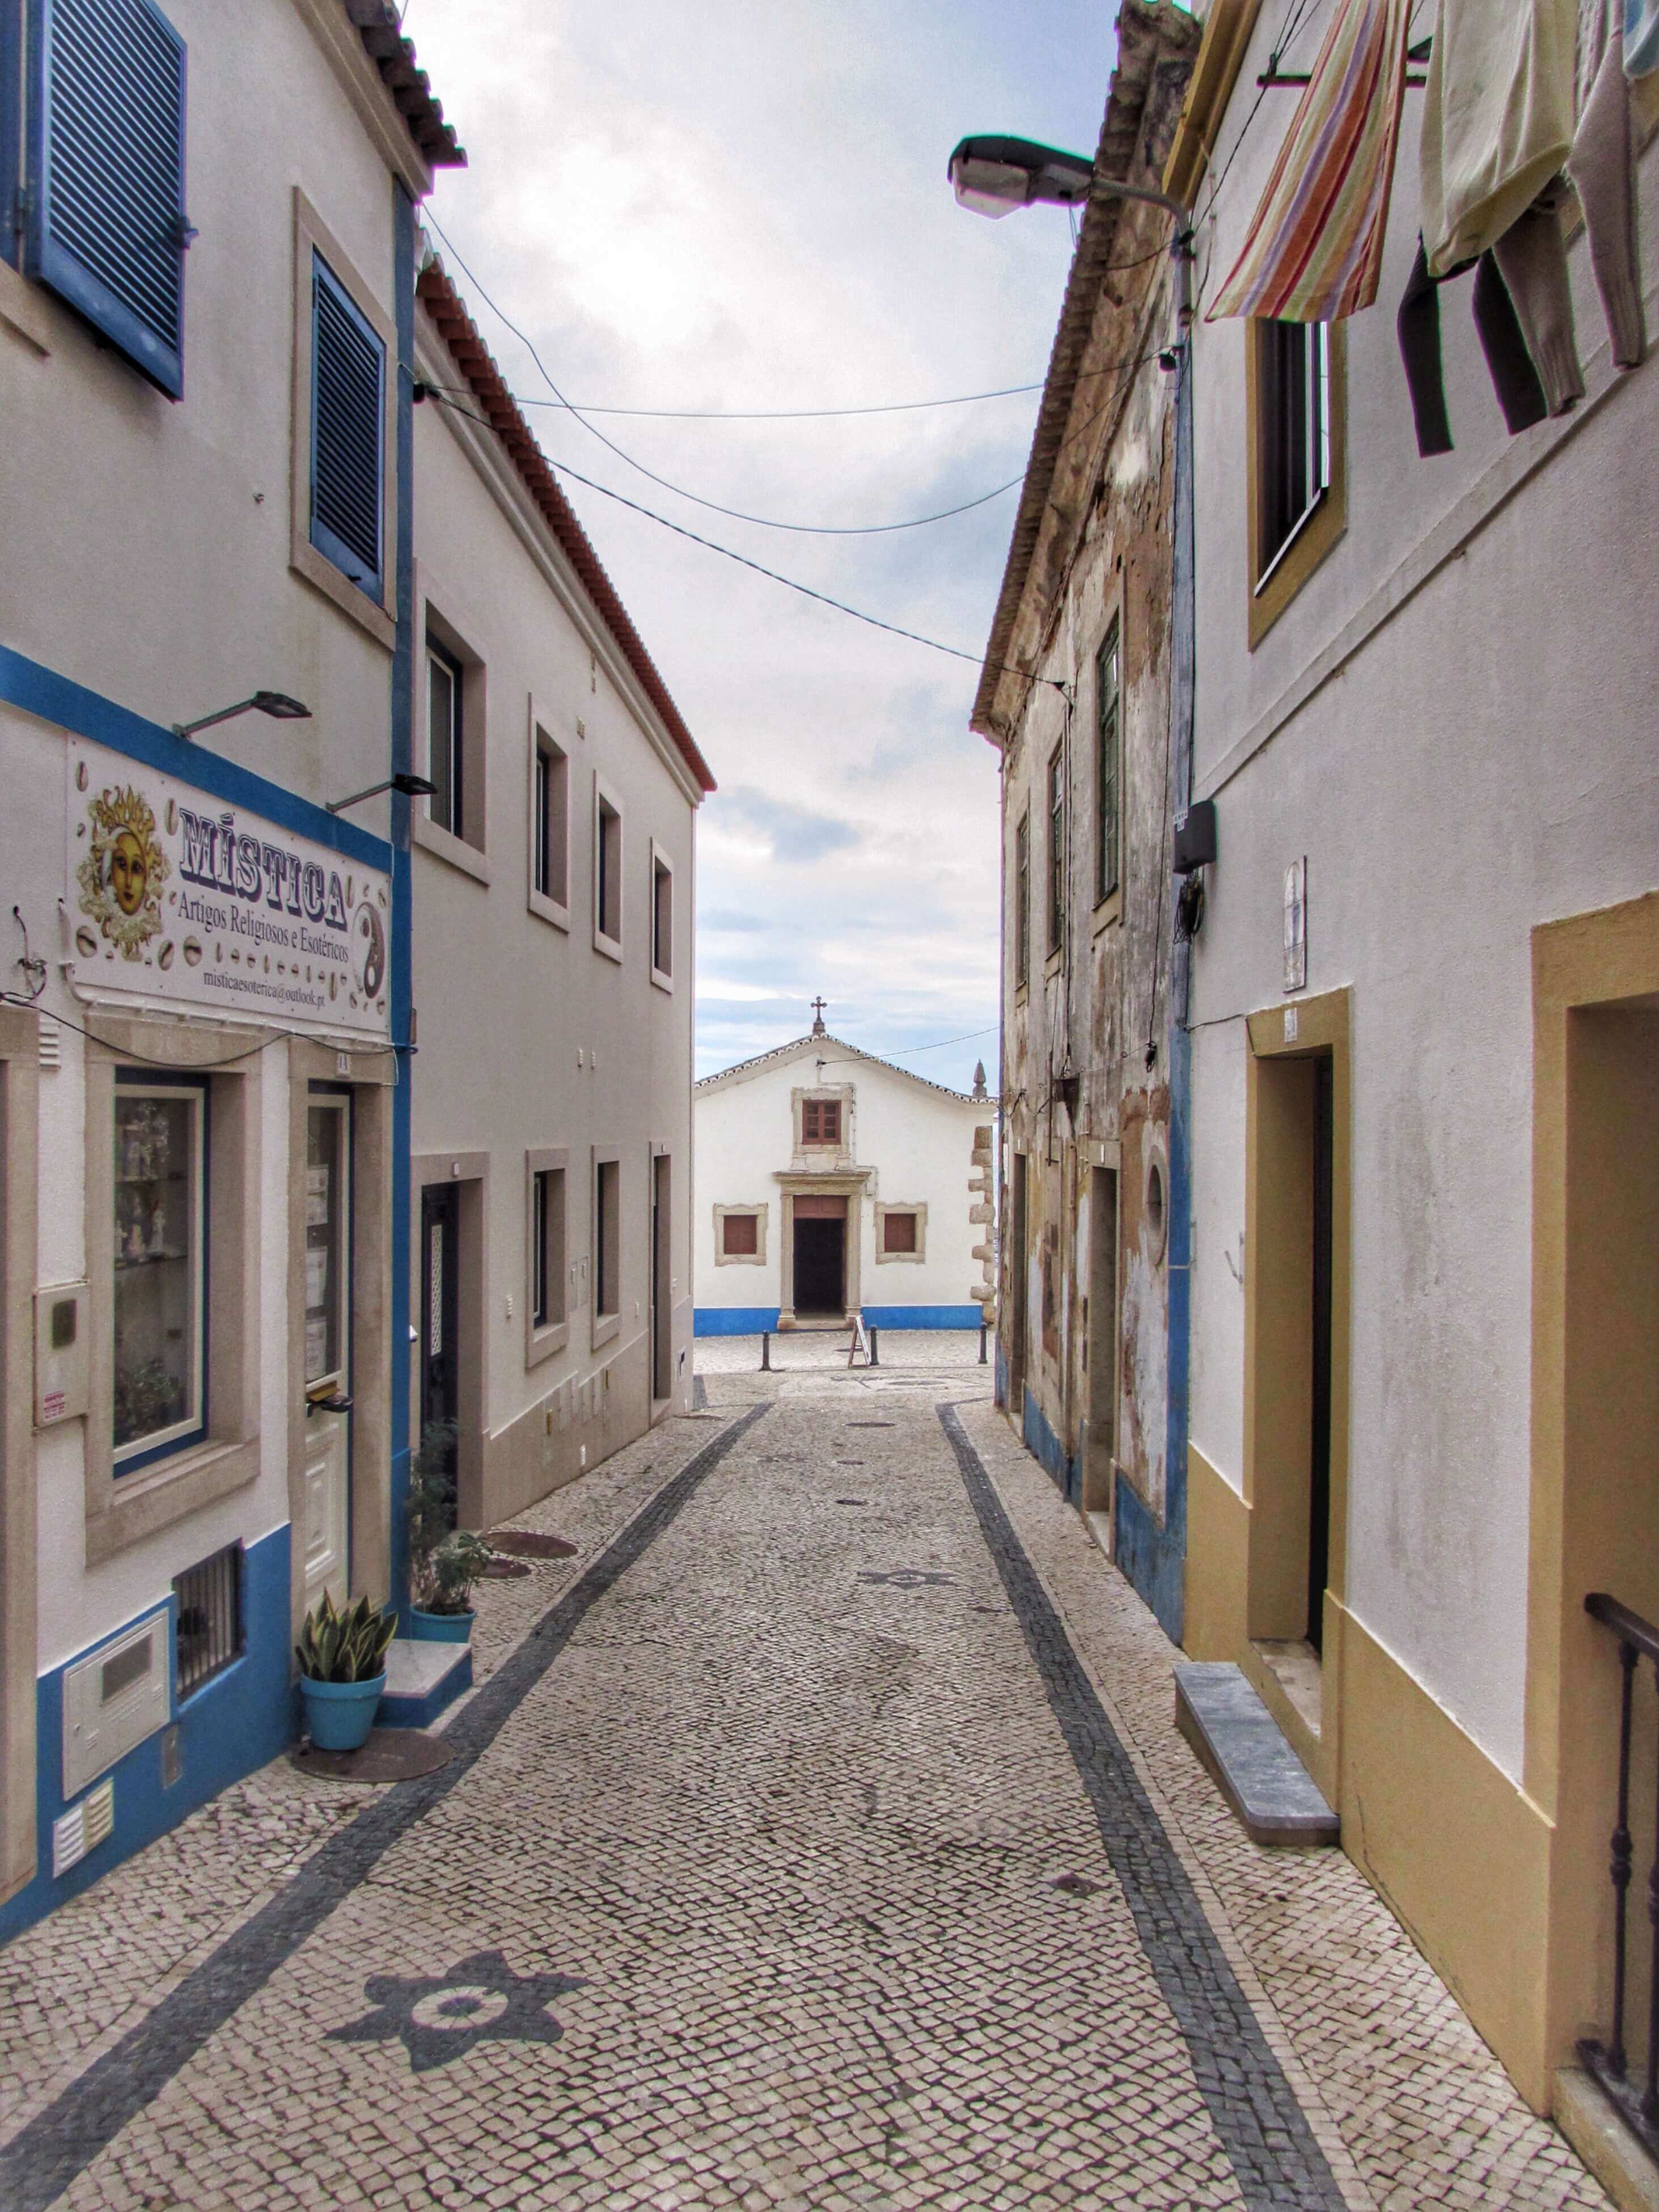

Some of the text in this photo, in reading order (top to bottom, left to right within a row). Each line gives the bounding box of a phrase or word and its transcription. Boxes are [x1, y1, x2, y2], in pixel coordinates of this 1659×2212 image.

[179, 808, 347, 932] MÍSTICA
[178, 891, 349, 963] Artigos Religiosos e Esotéricos
[204, 968, 325, 1009] misticaesoterica@outlook.pt
